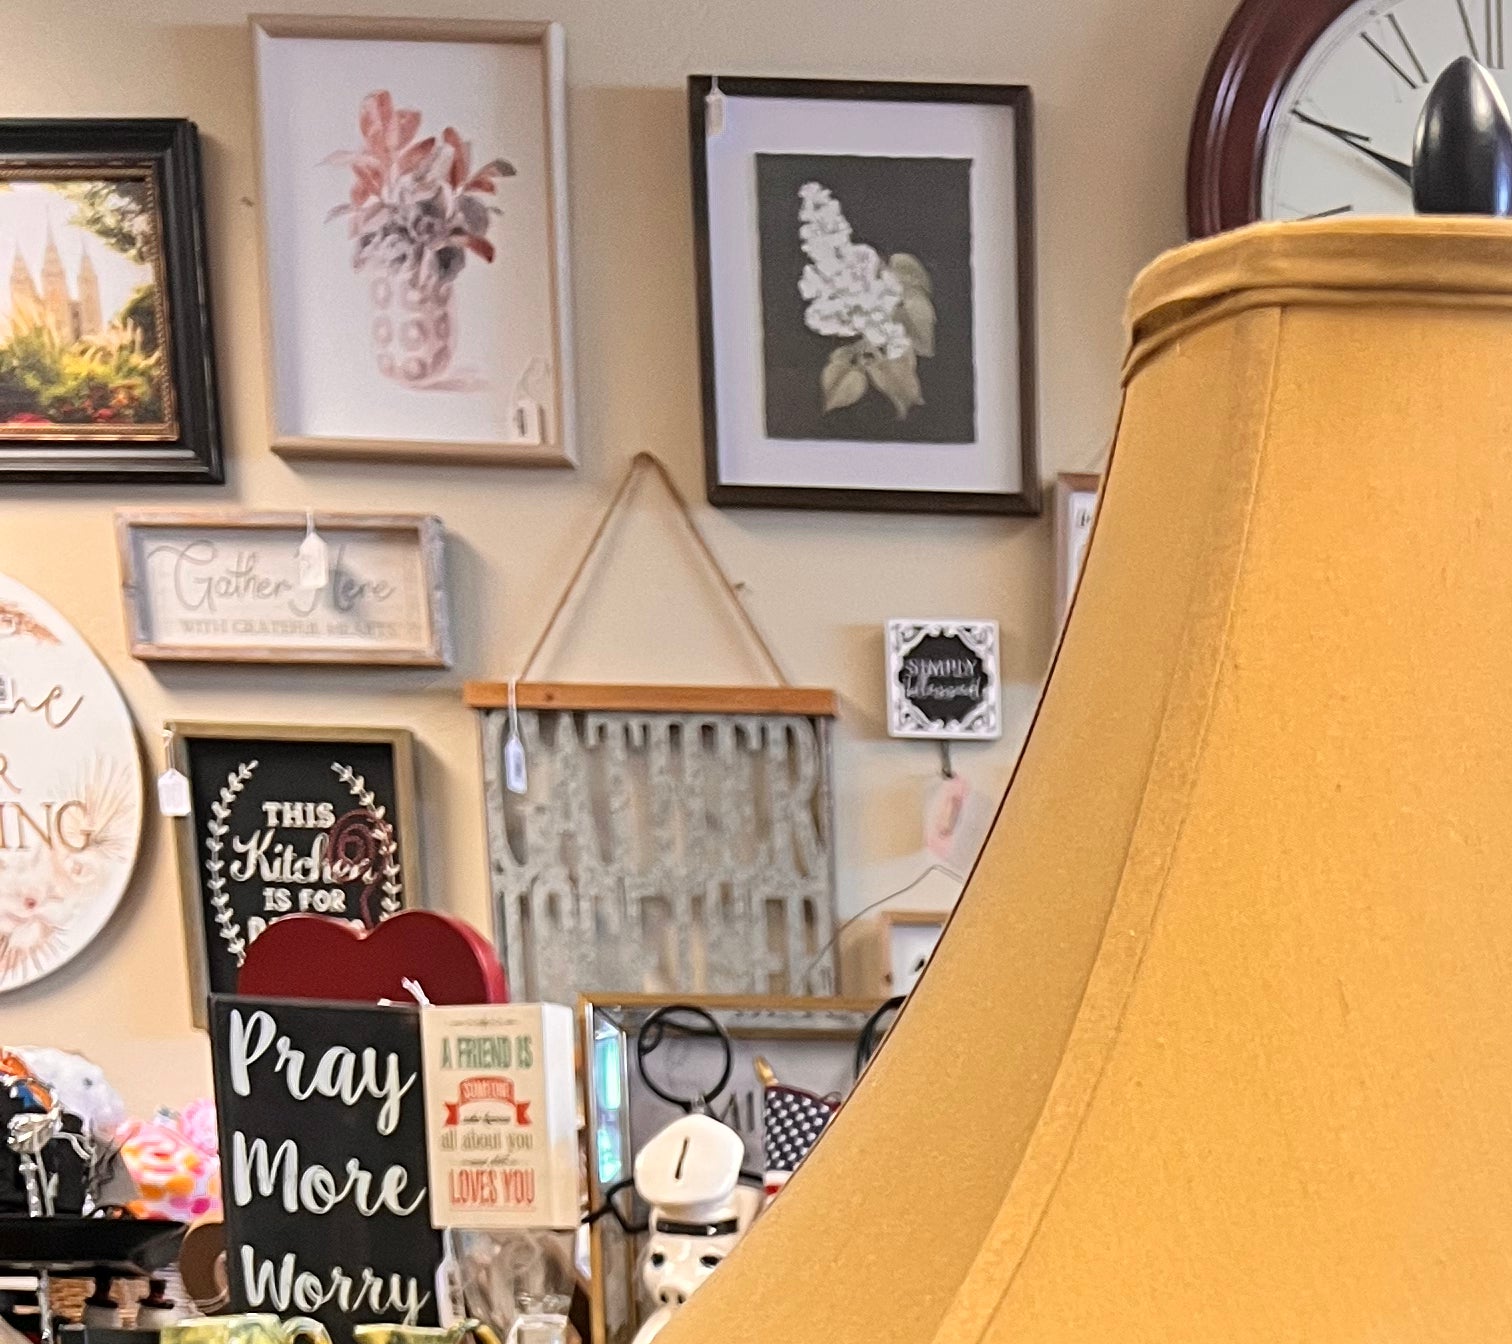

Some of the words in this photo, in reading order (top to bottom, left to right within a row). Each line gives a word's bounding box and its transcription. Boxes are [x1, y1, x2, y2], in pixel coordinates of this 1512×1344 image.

[147, 540, 293, 612] Gather
[262, 801, 336, 829] THIS
[262, 887, 292, 912] IS
[297, 888, 347, 913] FOR
[440, 1037, 453, 1069] A
[456, 1034, 512, 1070] FRIEND
[515, 1034, 534, 1070] IS
[230, 1008, 418, 1137] Pray
[441, 1131, 458, 1150] all
[463, 1130, 502, 1150] about
[232, 1130, 427, 1217] More
[450, 1168, 498, 1205] LOVES
[502, 1168, 535, 1205] YOU
[240, 1245, 430, 1325] Worry
